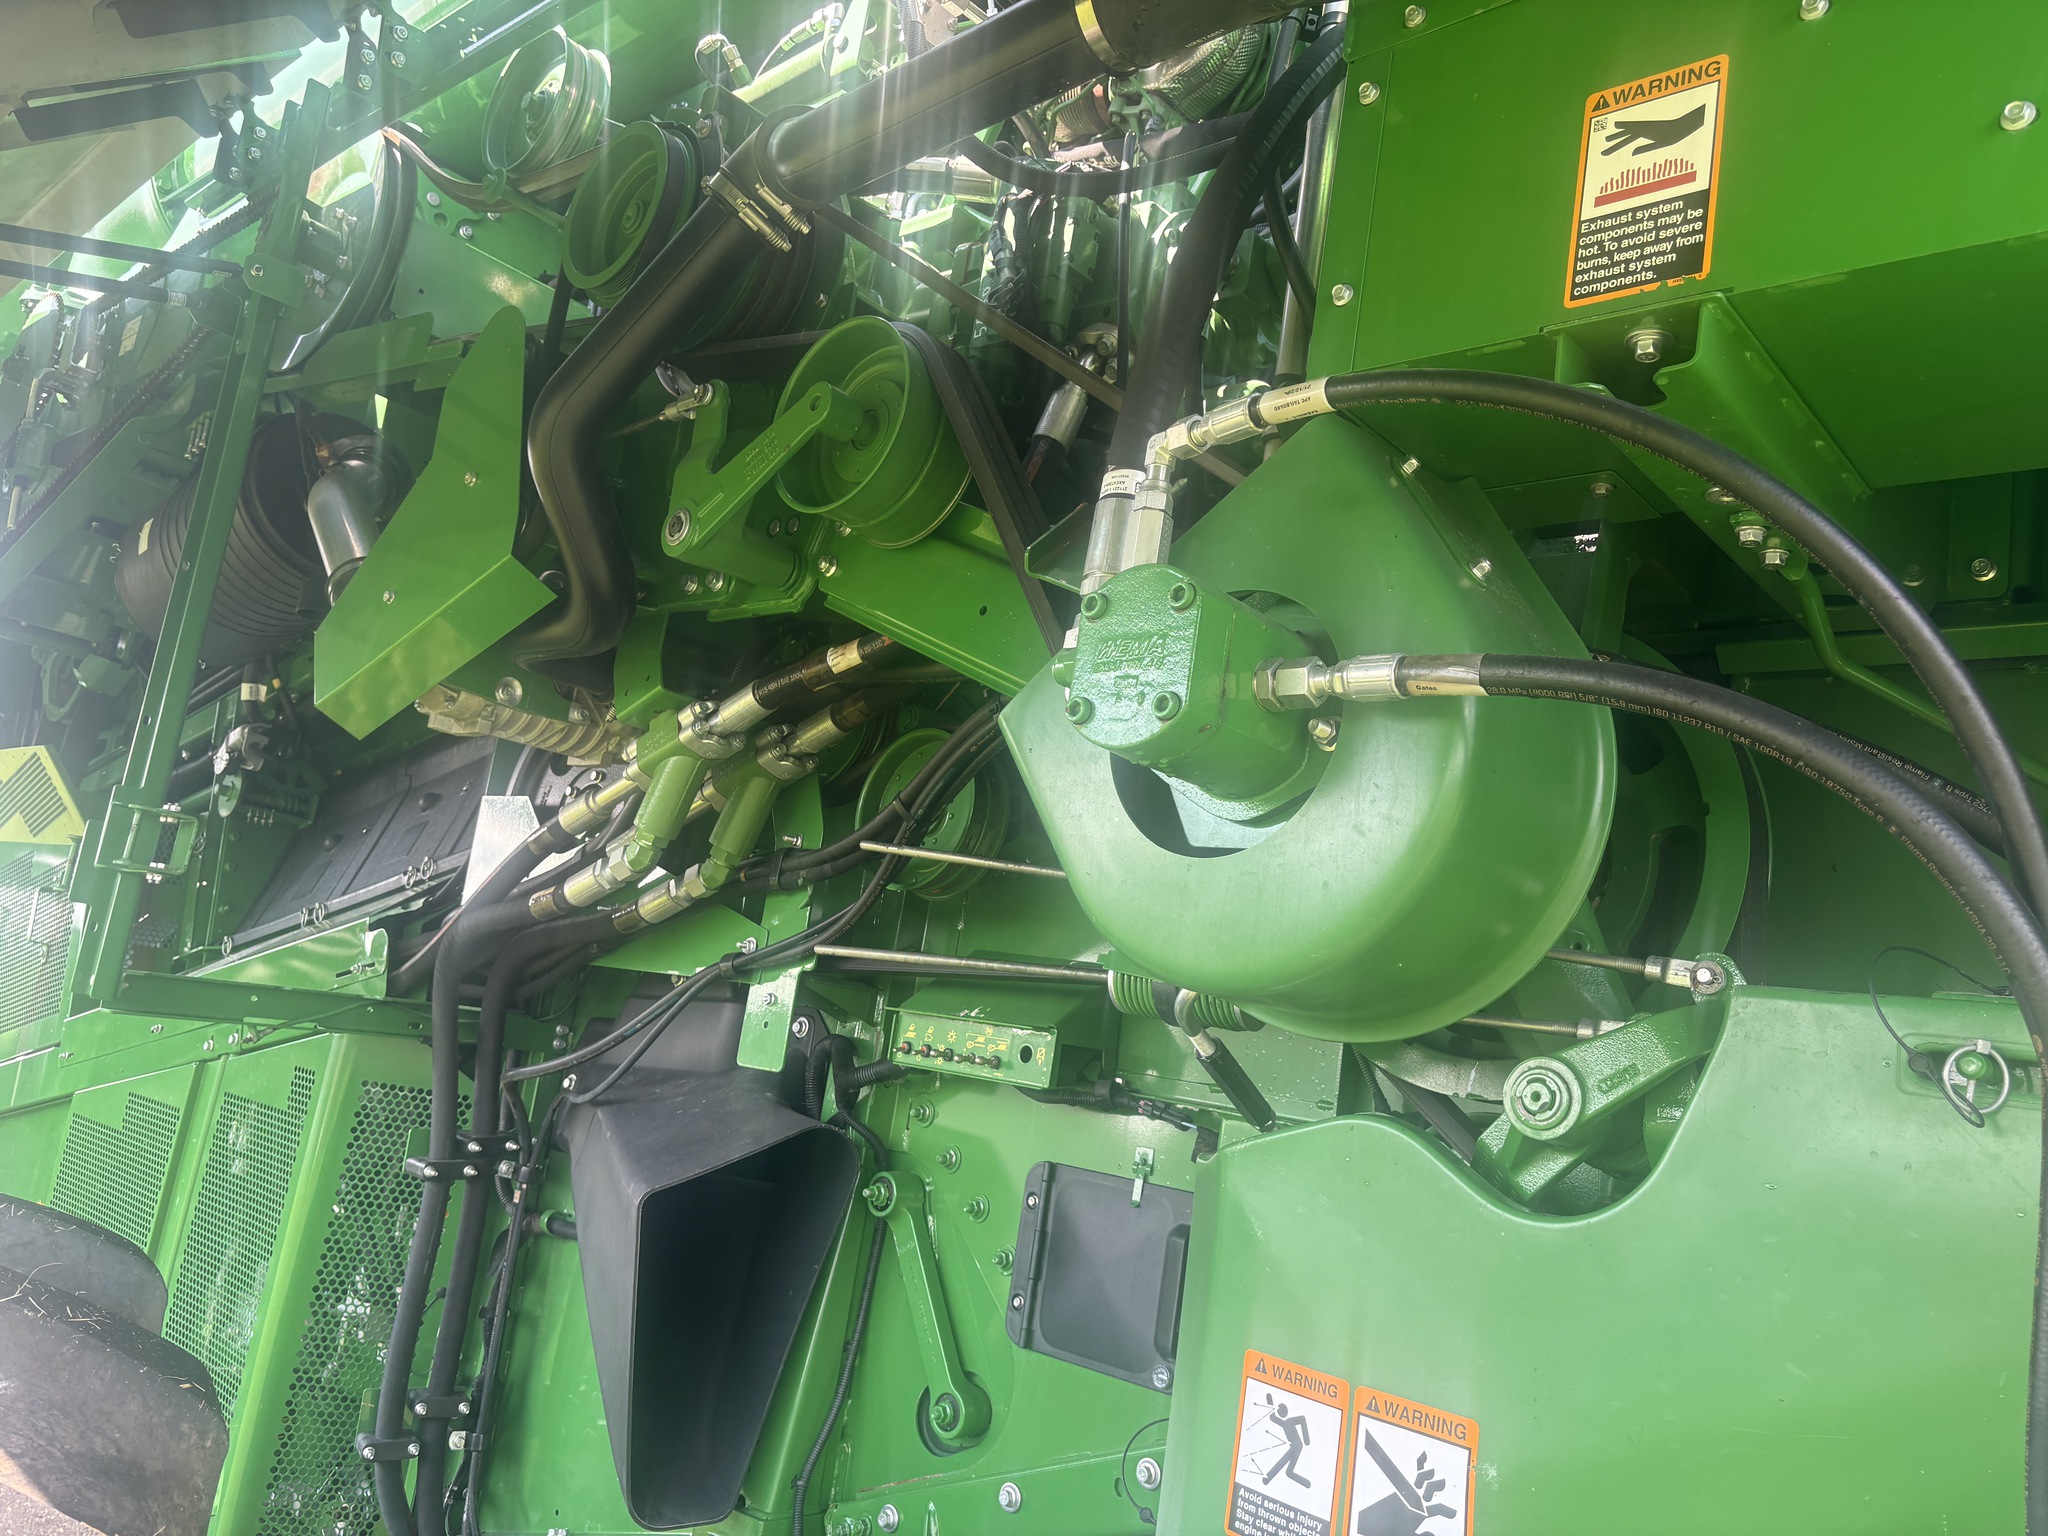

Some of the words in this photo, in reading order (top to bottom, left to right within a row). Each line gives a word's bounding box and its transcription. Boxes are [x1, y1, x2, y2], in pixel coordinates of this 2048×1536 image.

[1612, 60, 1721, 105] WARNING
[1579, 220, 1654, 246] components
[1657, 212, 1685, 227] may
[1687, 208, 1704, 219] be
[1581, 212, 1633, 233] Exhaust
[1635, 200, 1683, 220] system
[1576, 255, 1611, 271] burns,
[1613, 248, 1641, 263] keep
[1643, 240, 1673, 255] away
[1675, 233, 1704, 248] from
[1578, 245, 1601, 259] hot.
[1603, 241, 1618, 252] To
[1621, 231, 1656, 248] avoid
[1658, 221, 1703, 239] severe
[1573, 270, 1657, 296] components.
[1574, 263, 1625, 283] exhaust
[1628, 253, 1676, 271] system
[1864, 746, 1904, 768] Resistant
[1904, 764, 1930, 781] Flame
[1507, 687, 1528, 695] MPa
[1672, 712, 1702, 727] 11237
[1733, 733, 1751, 746] SAE
[1754, 742, 1793, 765] 100R19
[1900, 835, 1927, 863] Flame
[1927, 862, 1964, 904] Resistant
[1964, 906, 1986, 934] MSHA
[1954, 788, 1973, 805] Type
[1272, 1363, 1338, 1399] WARNING
[1384, 1400, 1467, 1441] WARNING
[1236, 1508, 1254, 1525] Stay
[1255, 1518, 1276, 1534] clear
[1237, 1497, 1256, 1513] from
[1258, 1507, 1287, 1527] thrown
[1239, 1487, 1262, 1505] Avoid
[1263, 1500, 1295, 1519] serious
[1297, 1512, 1322, 1532] injury
